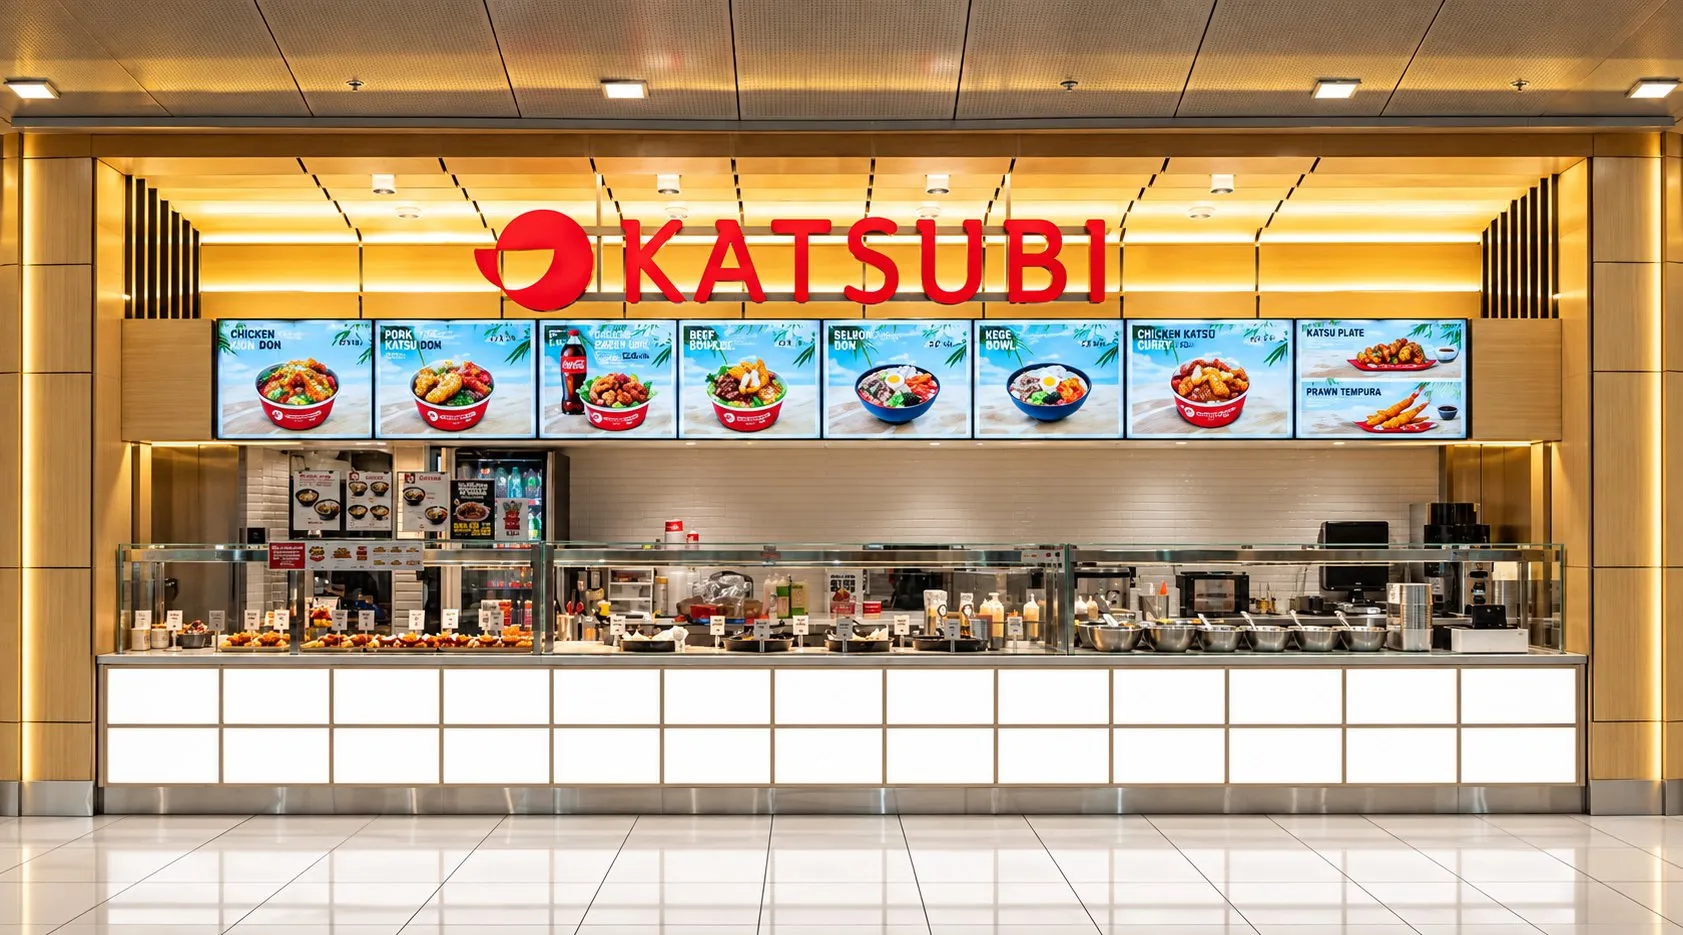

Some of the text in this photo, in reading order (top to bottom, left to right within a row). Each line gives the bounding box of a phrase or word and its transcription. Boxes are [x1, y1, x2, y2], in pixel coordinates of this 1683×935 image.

[623, 216, 1106, 305] KATSUBI
[230, 329, 275, 339] CHICKEN
[384, 329, 412, 340] PORK
[1137, 329, 1180, 340] CHICKEN
[1306, 328, 1365, 338] KATSU PLATE
[259, 340, 281, 350] DON
[385, 340, 417, 350] KATSU
[834, 340, 856, 351] DON
[1306, 387, 1382, 397] PRAWN TEMPURA
